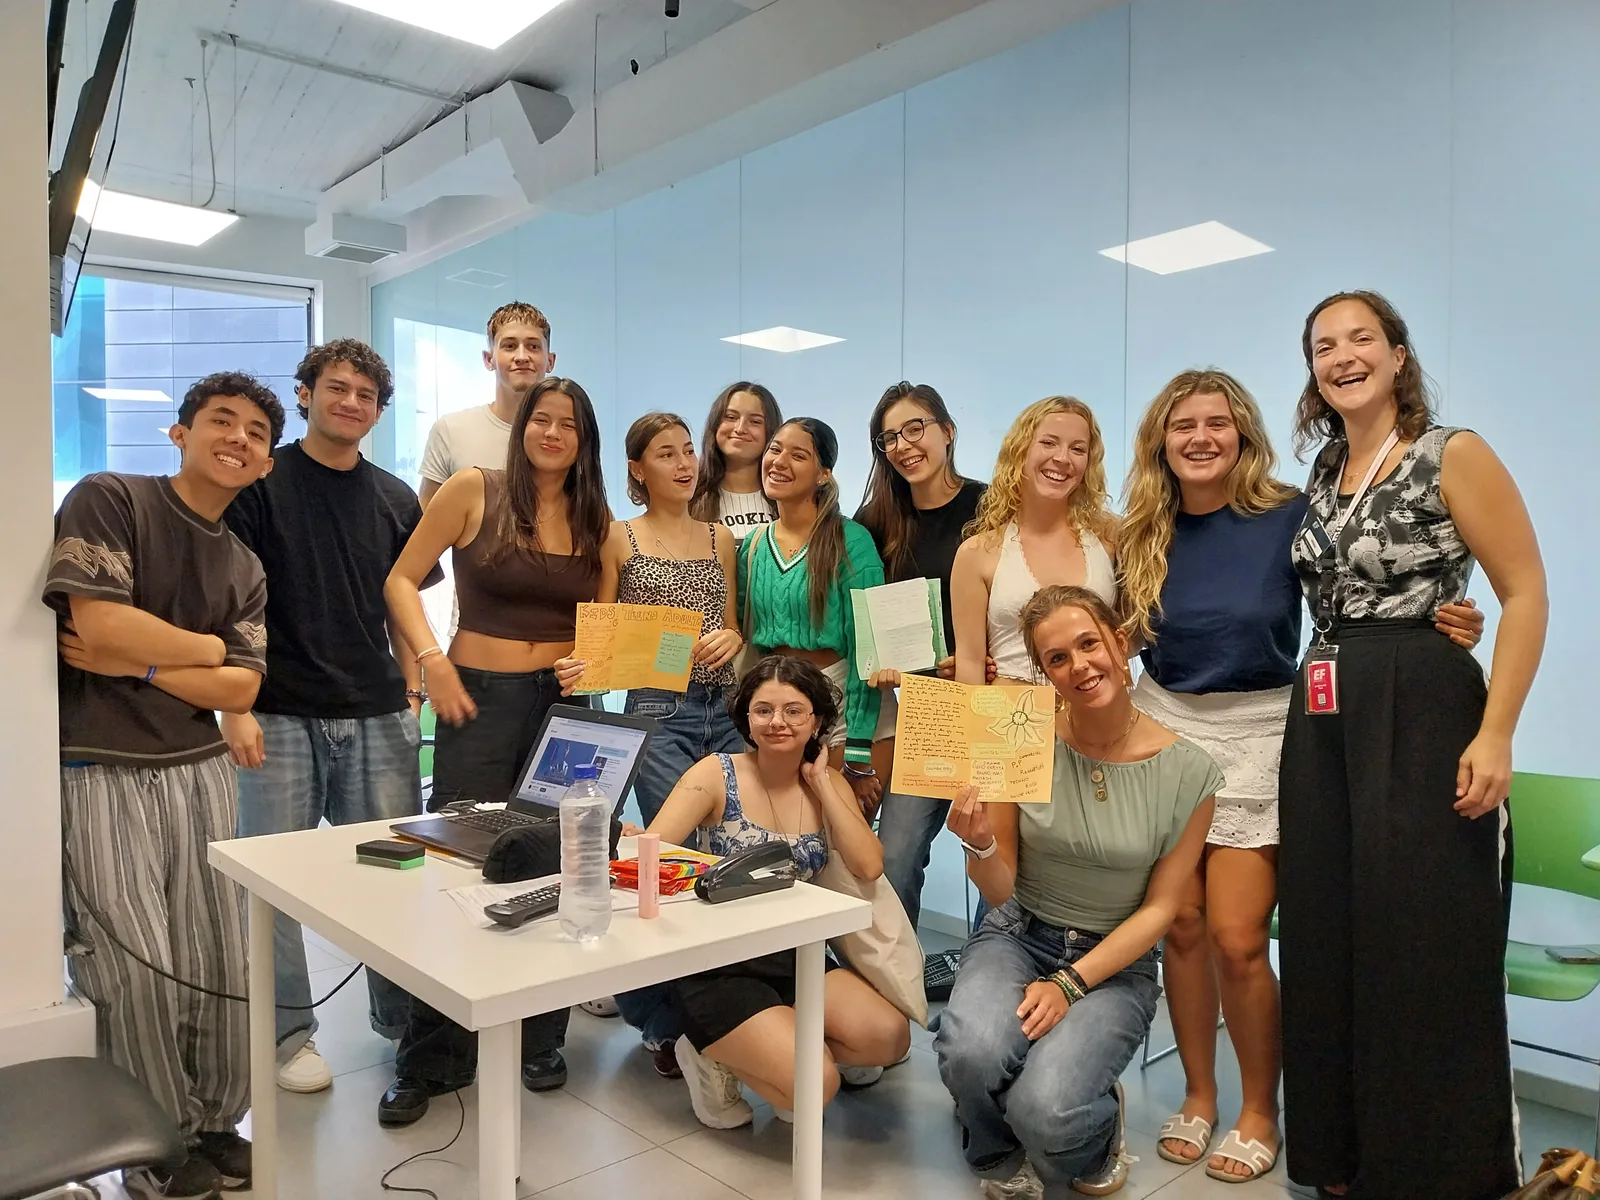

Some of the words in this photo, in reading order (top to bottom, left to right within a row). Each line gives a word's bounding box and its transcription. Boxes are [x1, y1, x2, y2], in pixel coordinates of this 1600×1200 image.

[718, 512, 775, 527] OOKL
[622, 604, 659, 622] TEENS
[1313, 668, 1326, 681] EF
